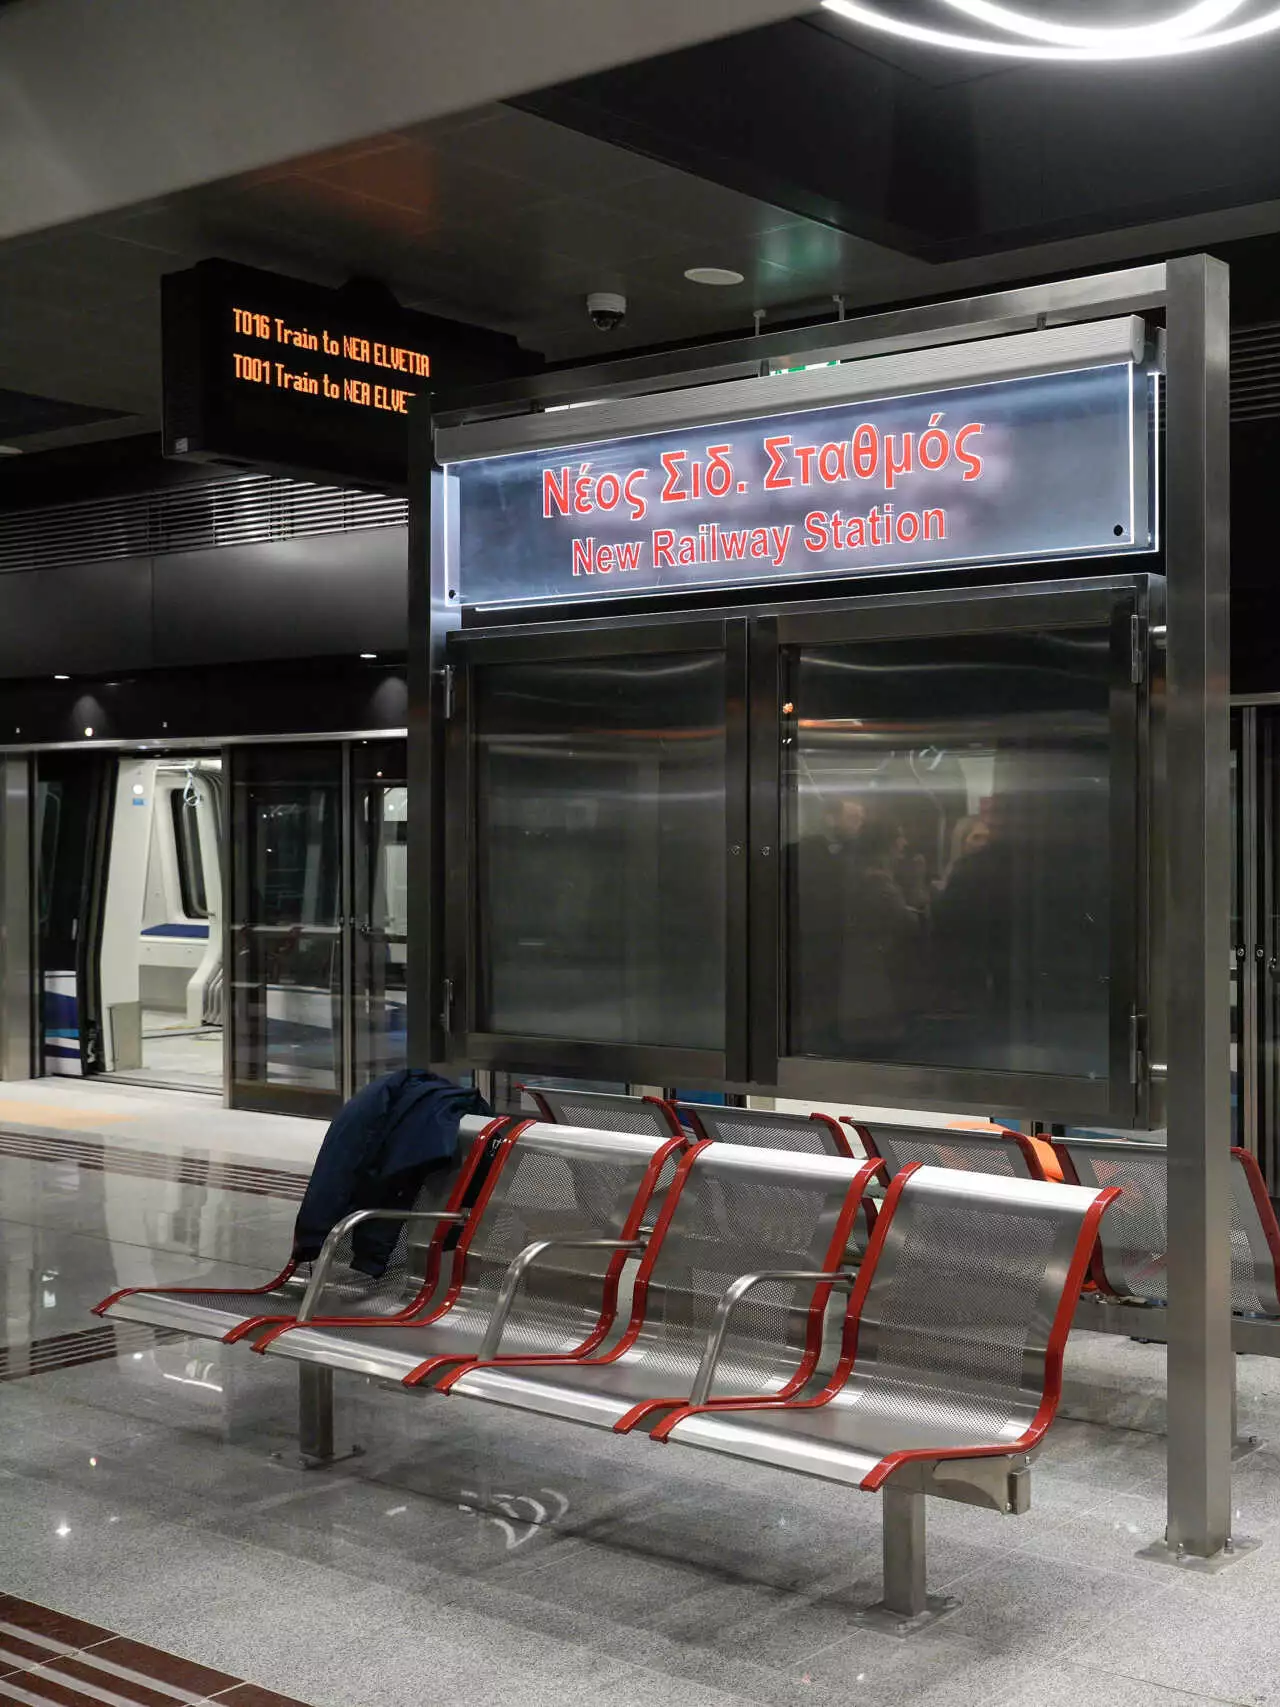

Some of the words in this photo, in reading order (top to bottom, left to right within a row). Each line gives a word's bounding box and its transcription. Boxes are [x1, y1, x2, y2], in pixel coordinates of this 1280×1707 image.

[233, 308, 270, 340] T016
[274, 318, 318, 351] Train
[322, 330, 339, 356] to
[343, 335, 370, 364] NEA
[374, 343, 431, 378] ELVETIA
[233, 353, 270, 385] T001
[274, 363, 318, 395] Train
[322, 374, 340, 399] to
[343, 378, 370, 406] NEA
[374, 385, 417, 414] ELVE
[542, 463, 648, 520] Νέος
[660, 444, 748, 503] Σιδ.
[763, 412, 985, 491] Σταθμός
[572, 538, 644, 576] New
[652, 523, 793, 567] Railway
[803, 503, 947, 553] Station
